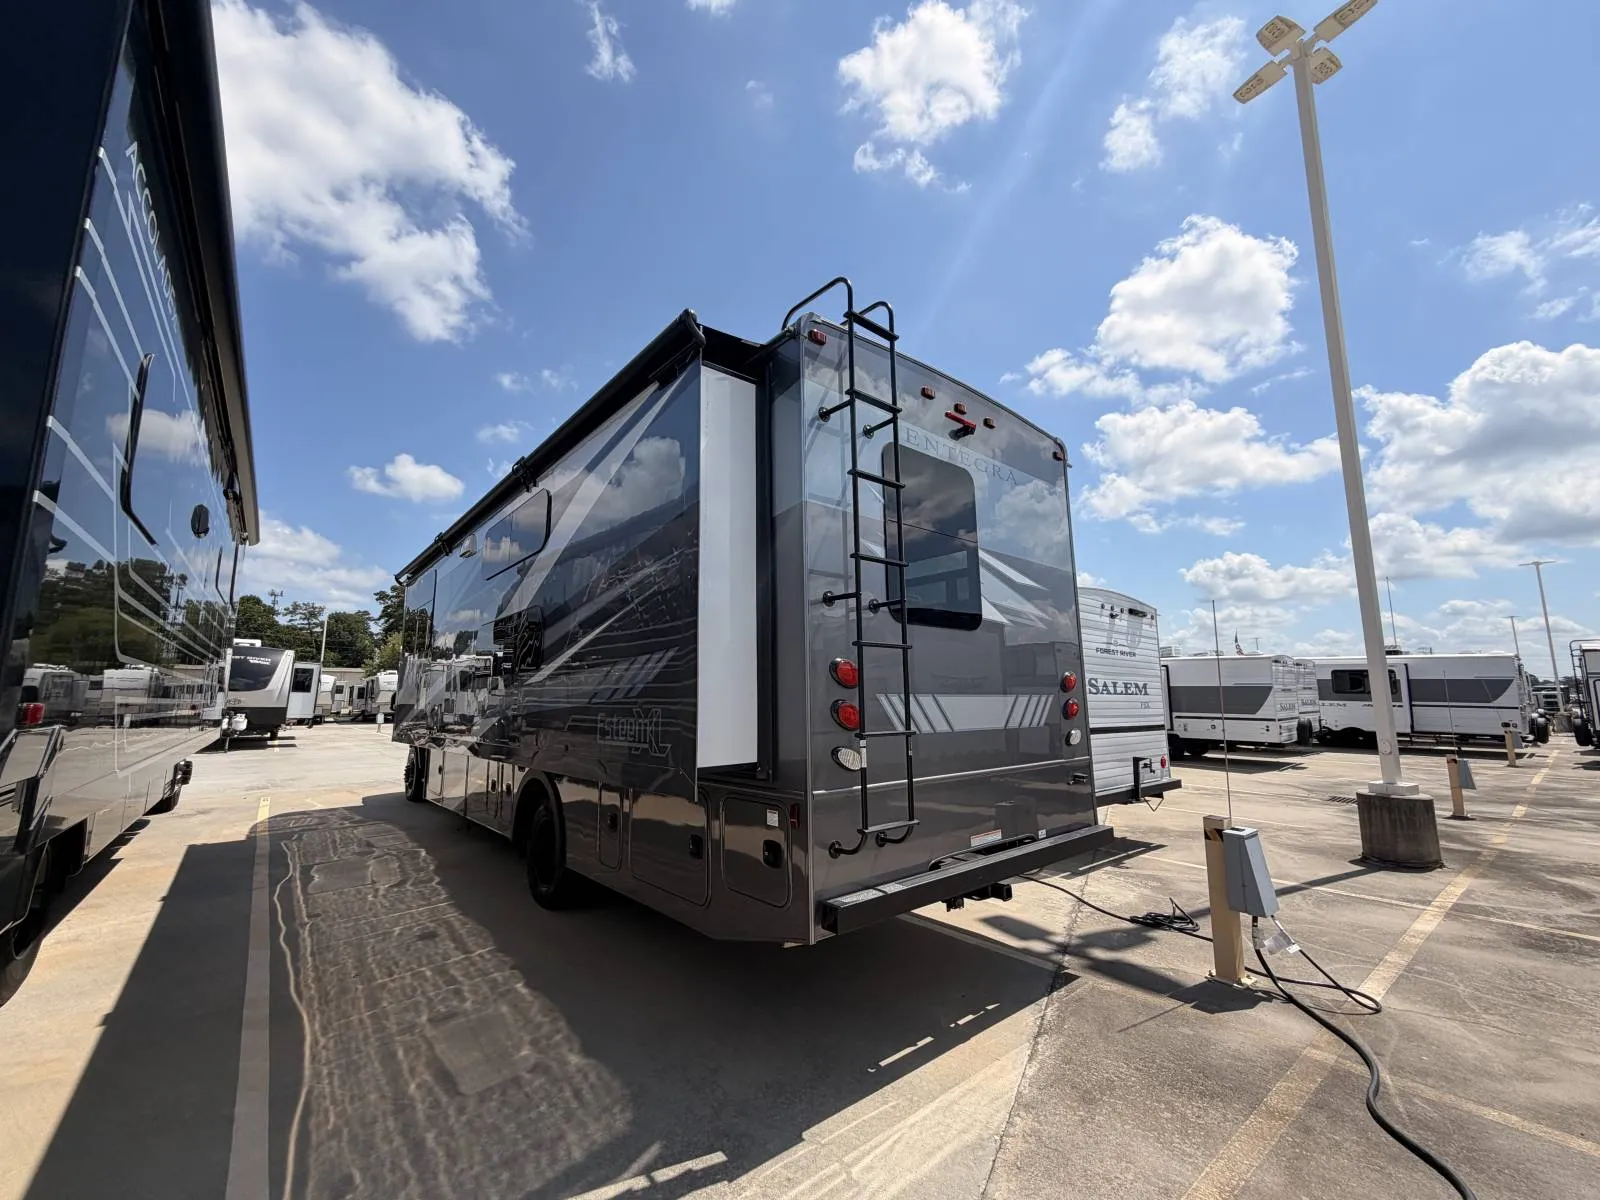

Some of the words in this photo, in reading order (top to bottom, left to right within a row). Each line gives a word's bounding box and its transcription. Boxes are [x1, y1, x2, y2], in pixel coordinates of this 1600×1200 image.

[125, 141, 176, 315] ACCOLADE
[906, 428, 1017, 485] ENTEGRA
[1096, 647, 1119, 656] FOREST
[1119, 650, 1137, 658] RIVER
[1087, 677, 1149, 696] SALEM
[596, 712, 649, 747] Esteem
